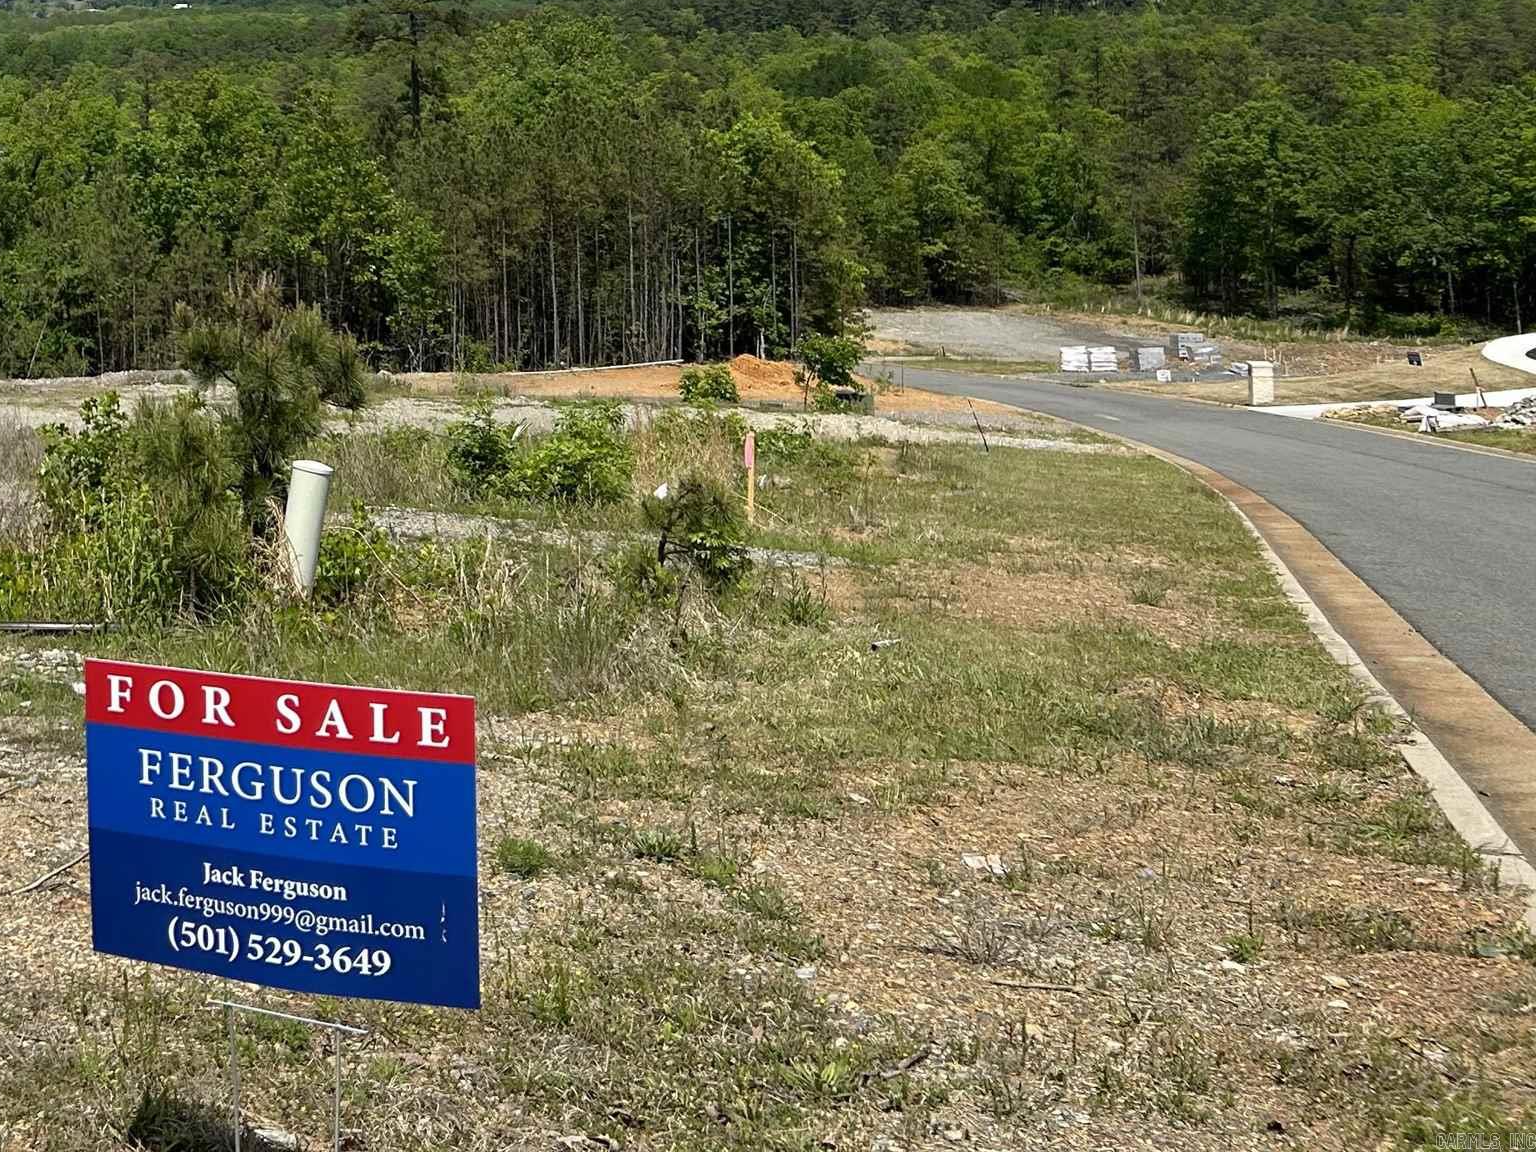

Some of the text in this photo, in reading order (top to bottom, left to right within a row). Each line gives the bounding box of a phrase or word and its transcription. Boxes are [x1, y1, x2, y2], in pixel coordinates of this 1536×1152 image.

[107, 673, 450, 748] FOR SALE
[138, 748, 418, 818] FERGUSON
[150, 797, 399, 849] REAL ESTATE
[134, 881, 426, 941] jack.ferguson999@gmail.com
[202, 862, 347, 901] Jack Ferguson
[167, 917, 391, 977] (501) 529-3649
